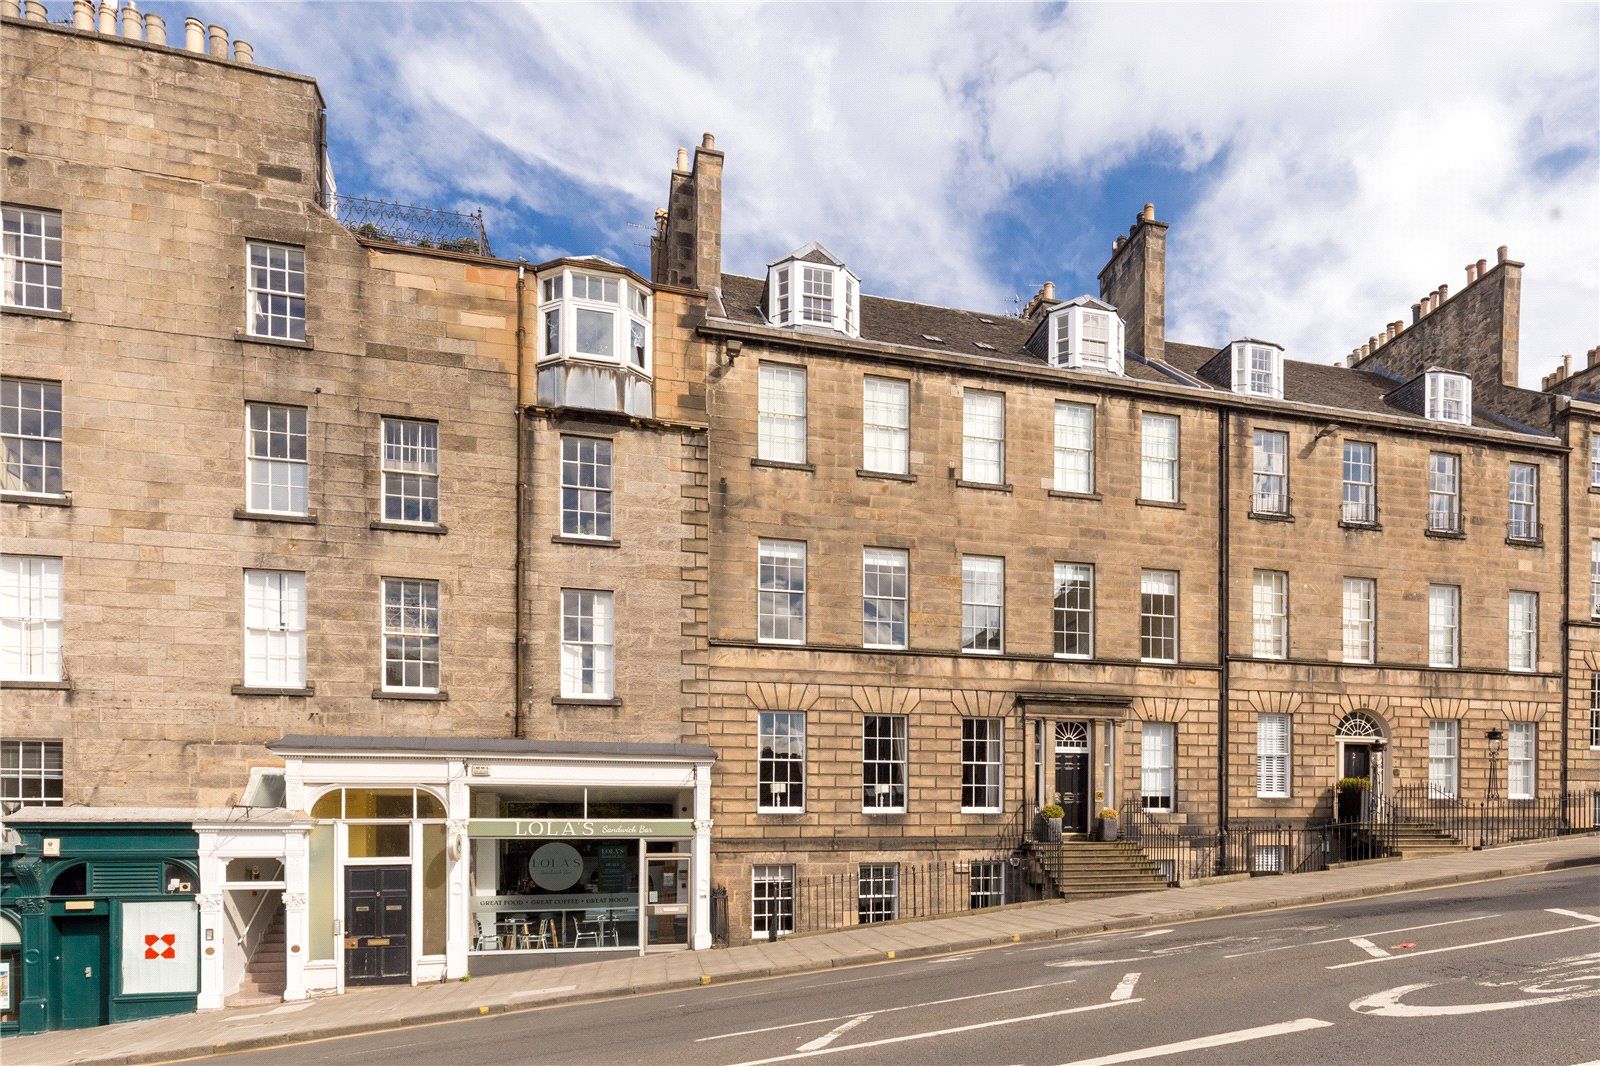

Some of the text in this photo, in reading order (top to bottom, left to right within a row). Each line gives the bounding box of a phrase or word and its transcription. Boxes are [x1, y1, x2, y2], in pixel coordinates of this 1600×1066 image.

[514, 821, 653, 836] LOLA'S Sandwich Bar
